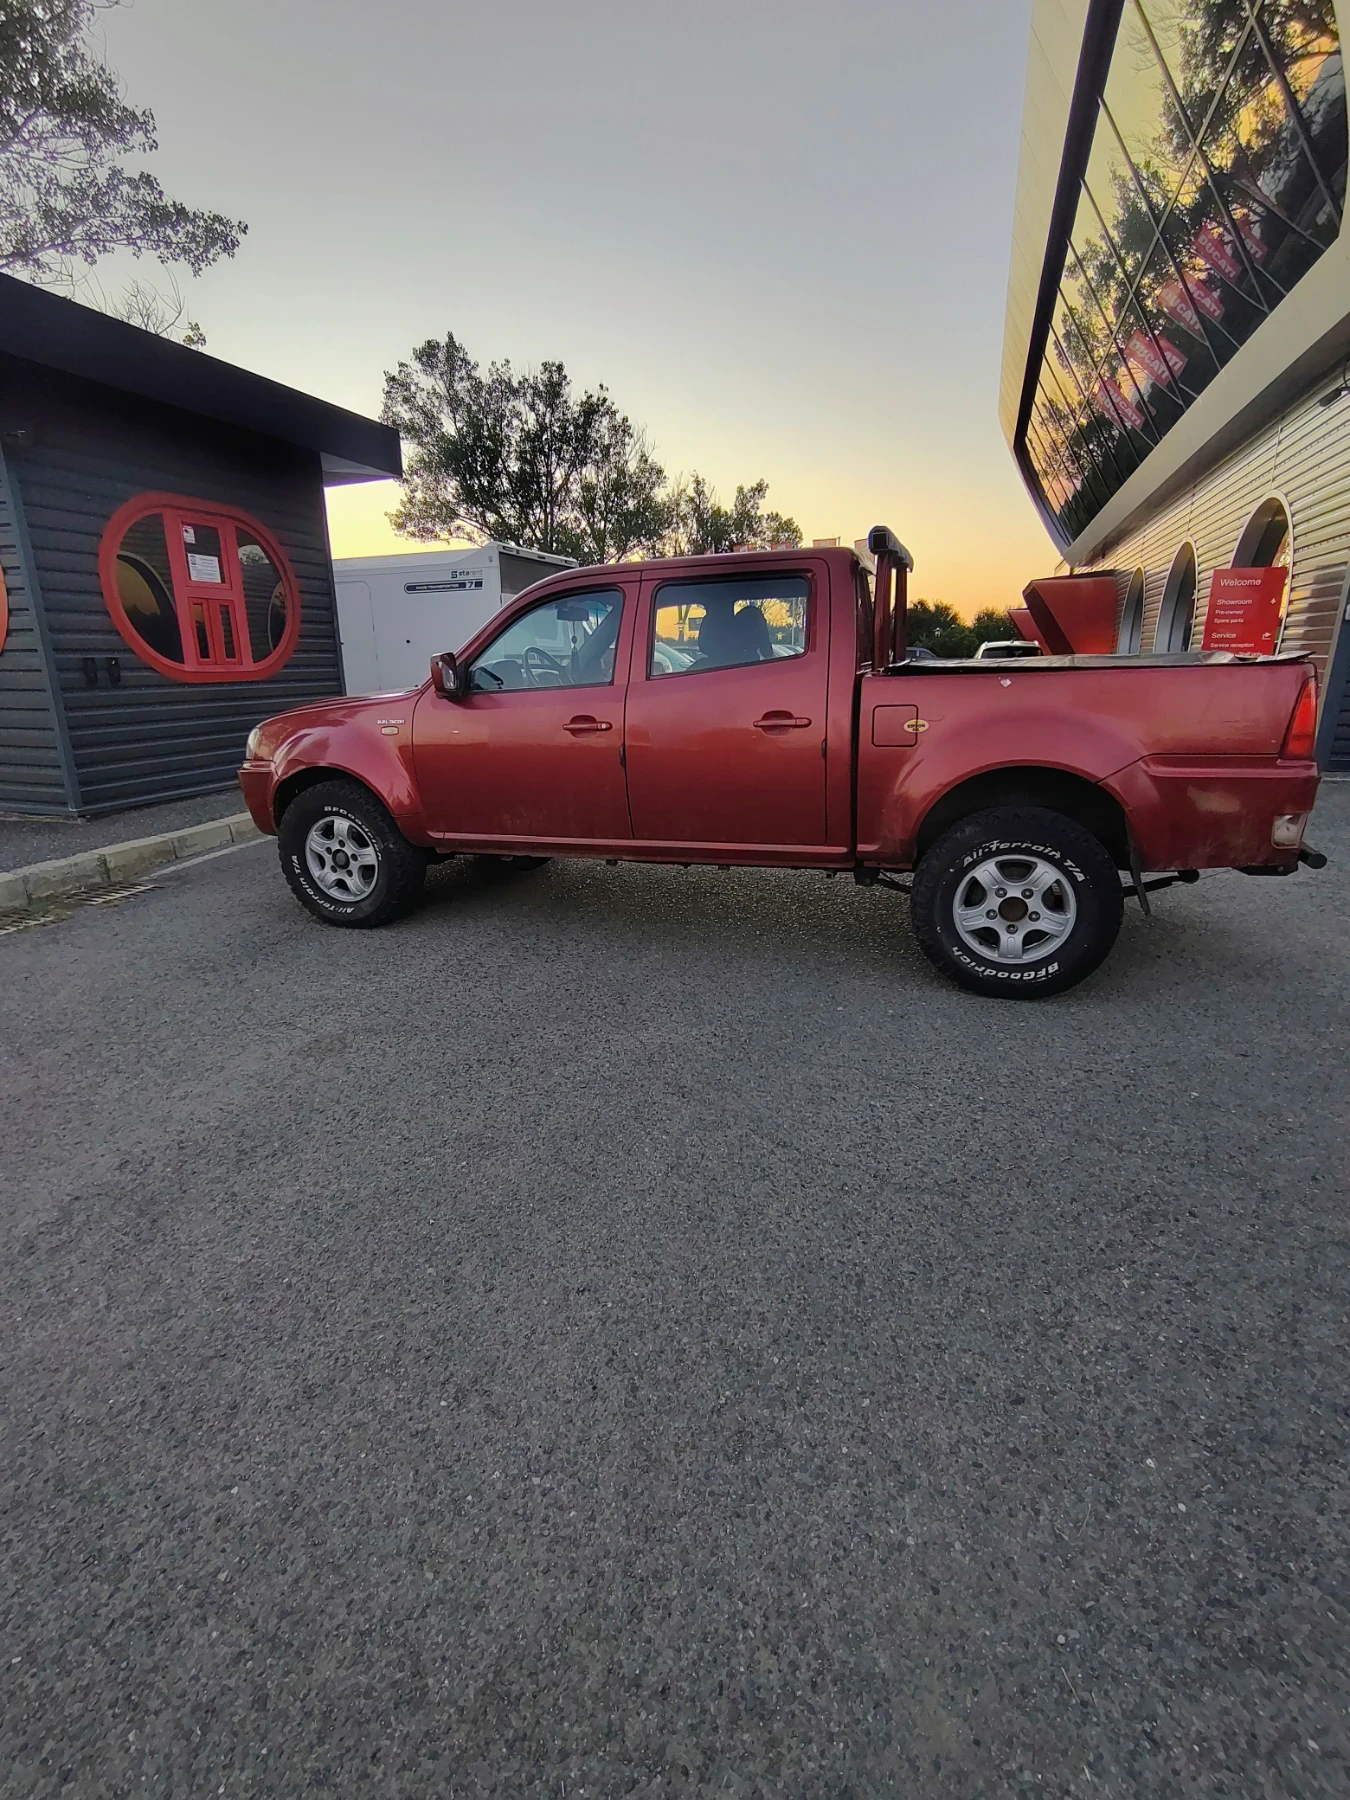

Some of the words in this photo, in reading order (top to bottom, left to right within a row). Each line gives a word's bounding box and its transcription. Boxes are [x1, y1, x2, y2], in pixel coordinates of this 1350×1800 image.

[1197, 234, 1236, 278] DUCATI
[1187, 282, 1221, 317] UCATI
[1129, 340, 1169, 380] DUCATI
[467, 581, 474, 589] 7
[1220, 578, 1261, 587] Welcome
[291, 855, 301, 874] T/A
[963, 840, 1060, 867] All-Terrain
[1064, 859, 1086, 882] T/A
[300, 877, 355, 913] All-Terrain
[952, 946, 1059, 980] BFGoodrich
